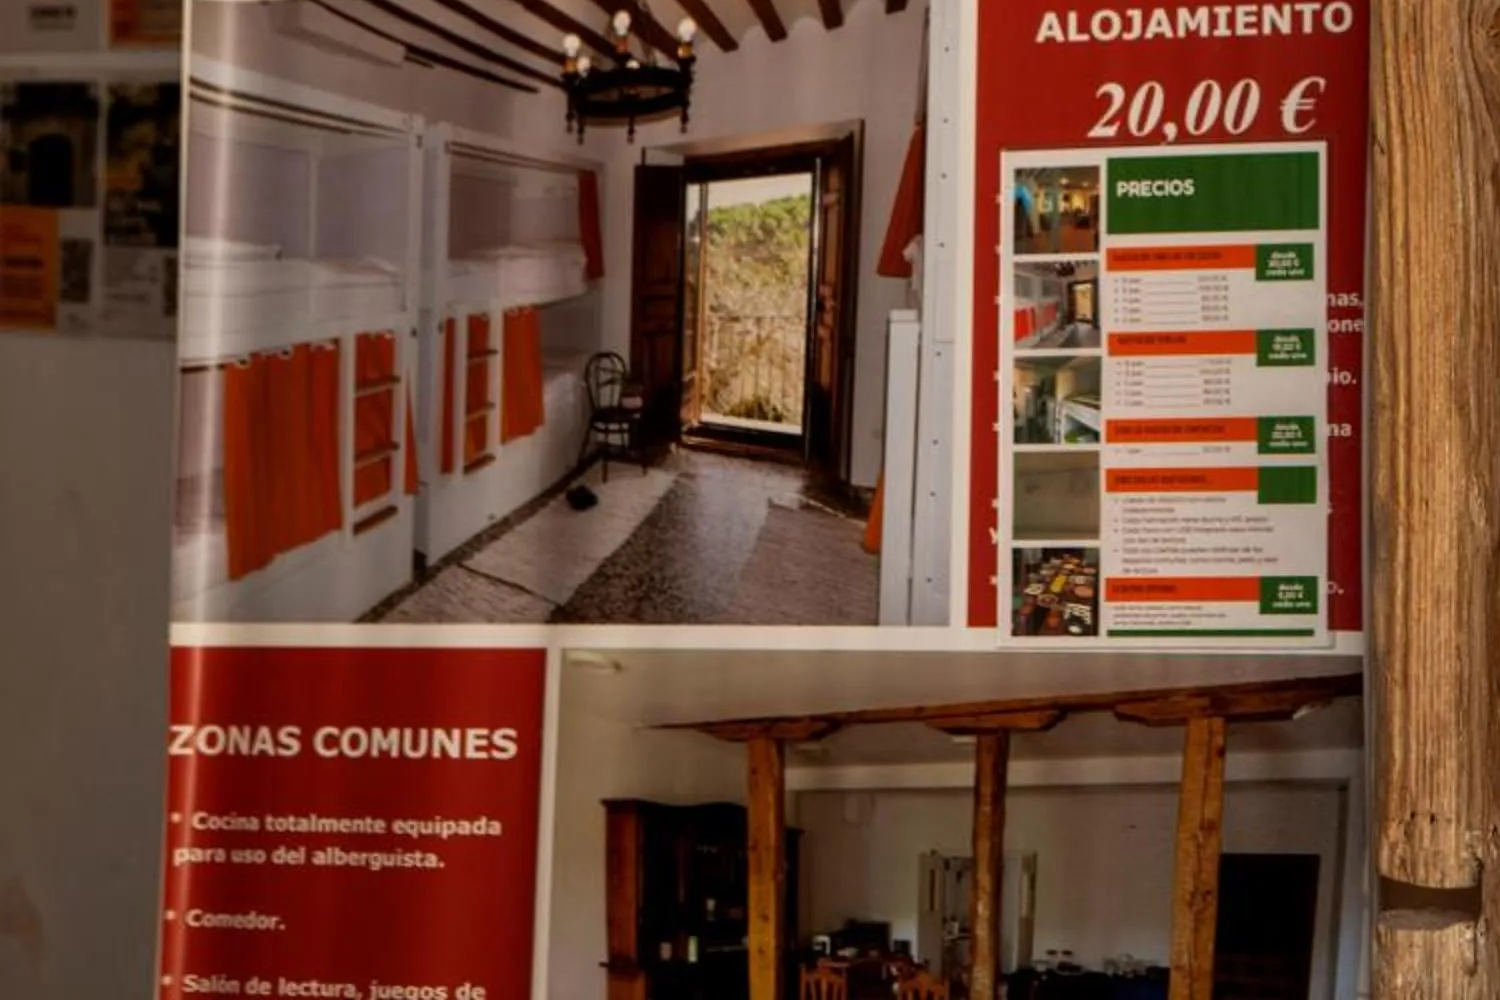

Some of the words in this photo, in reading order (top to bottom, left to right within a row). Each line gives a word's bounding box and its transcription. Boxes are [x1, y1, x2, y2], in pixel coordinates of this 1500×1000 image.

[1035, 1, 1354, 44] ALOJAMIENTO
[1087, 77, 1261, 144] 20,00
[1279, 76, 1326, 134] €
[1116, 179, 1195, 198] PRECIOS
[168, 725, 302, 758] ZONAS
[313, 726, 518, 760] COMUNES
[191, 811, 260, 832] Cocina
[265, 813, 386, 835] totalmente
[392, 816, 502, 839] equipada
[173, 846, 226, 867] para
[230, 847, 267, 865] uso
[271, 846, 307, 866] del
[311, 846, 446, 871] alberguista.
[185, 909, 286, 931] Comedor.
[182, 973, 241, 994] Salón
[245, 976, 272, 996] de
[277, 977, 363, 999] lectura,
[455, 982, 487, 1000] de
